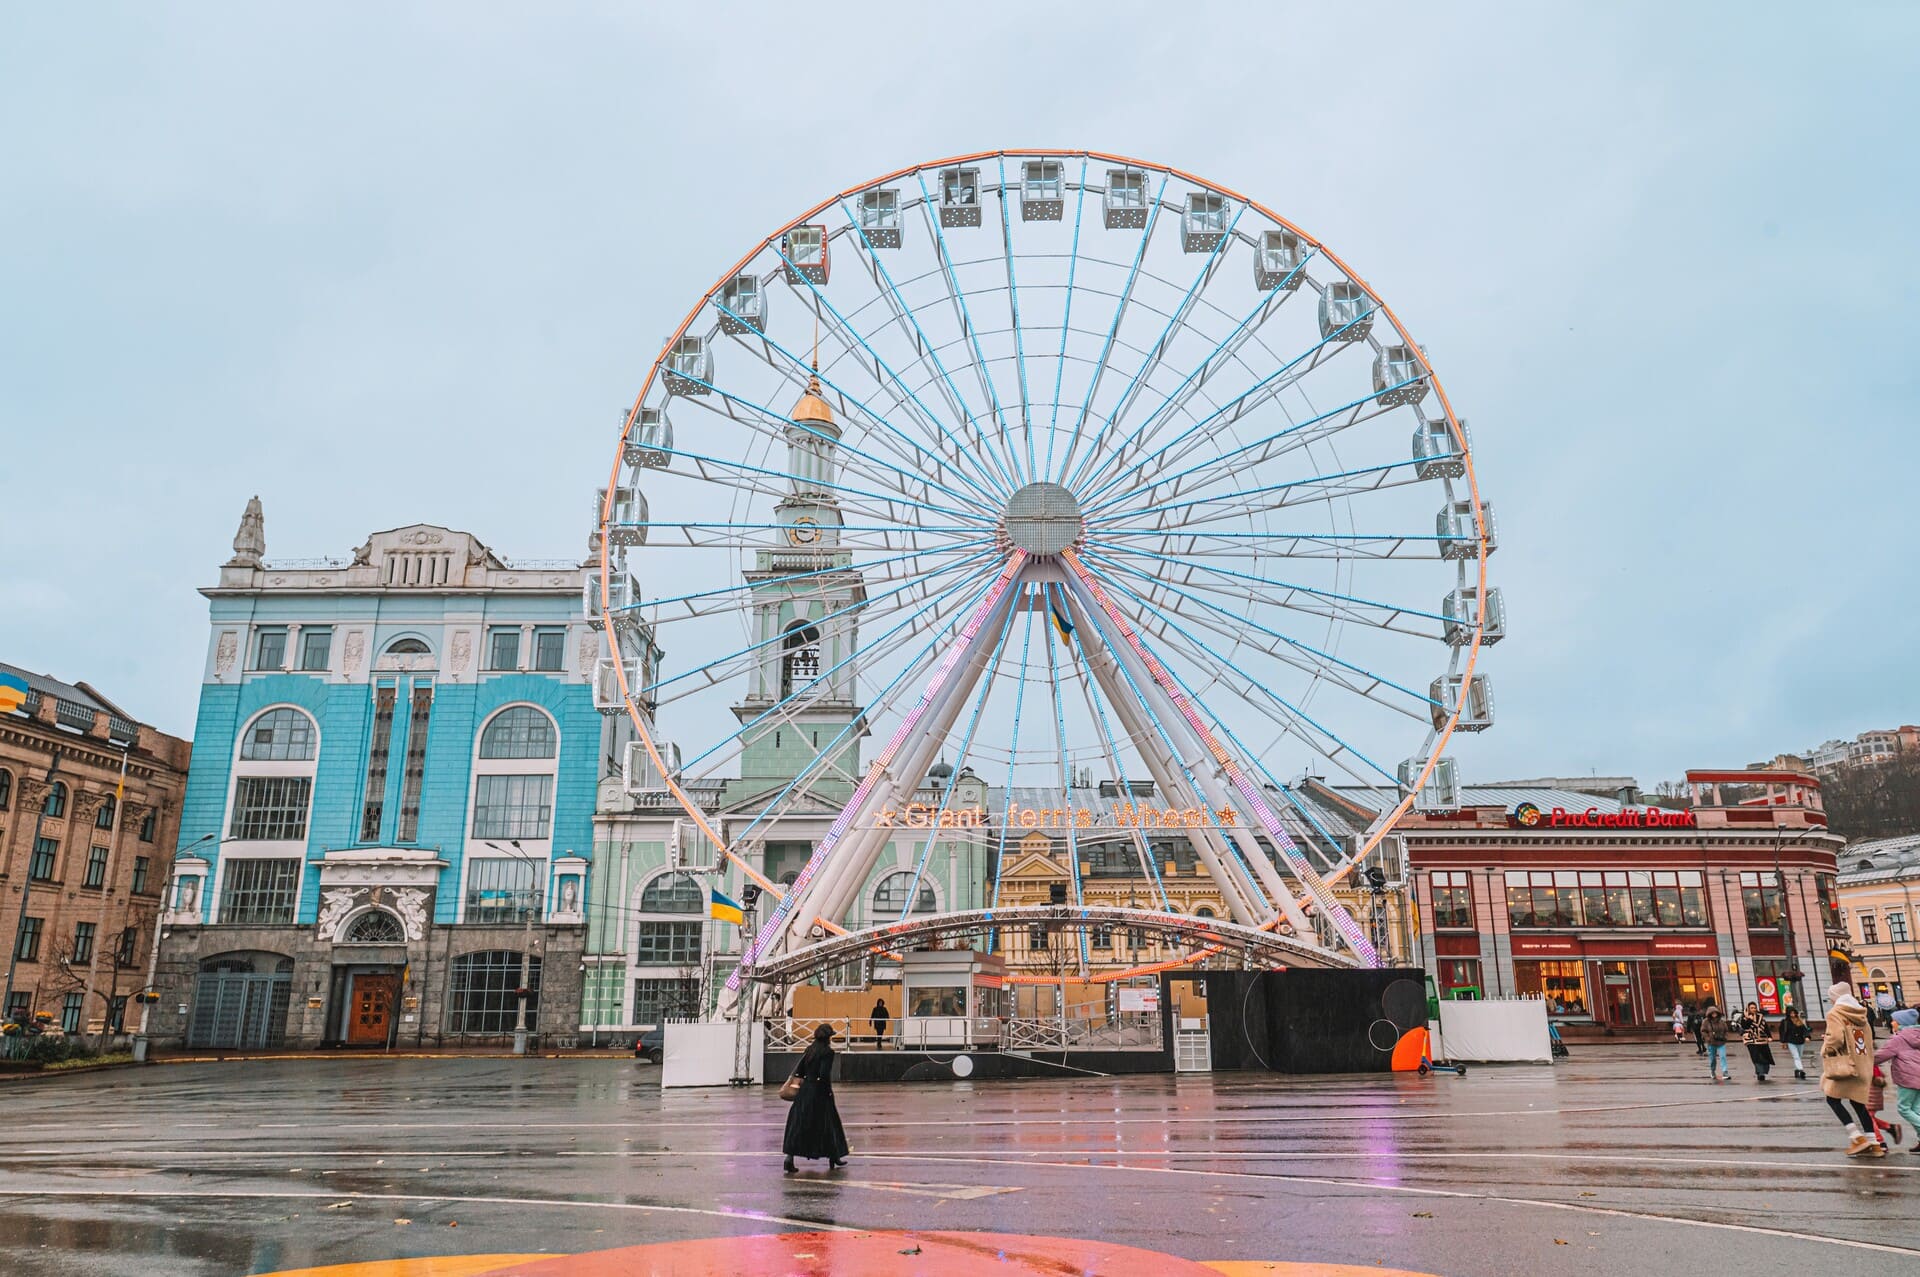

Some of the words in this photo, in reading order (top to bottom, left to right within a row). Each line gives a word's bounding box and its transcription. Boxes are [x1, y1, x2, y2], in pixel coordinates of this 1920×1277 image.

[905, 802, 983, 828] Giant
[1008, 803, 1091, 828] ferris
[1112, 802, 1208, 828] Wheel
[1551, 806, 1639, 827] ProCredit
[1646, 806, 1695, 827] Bank
